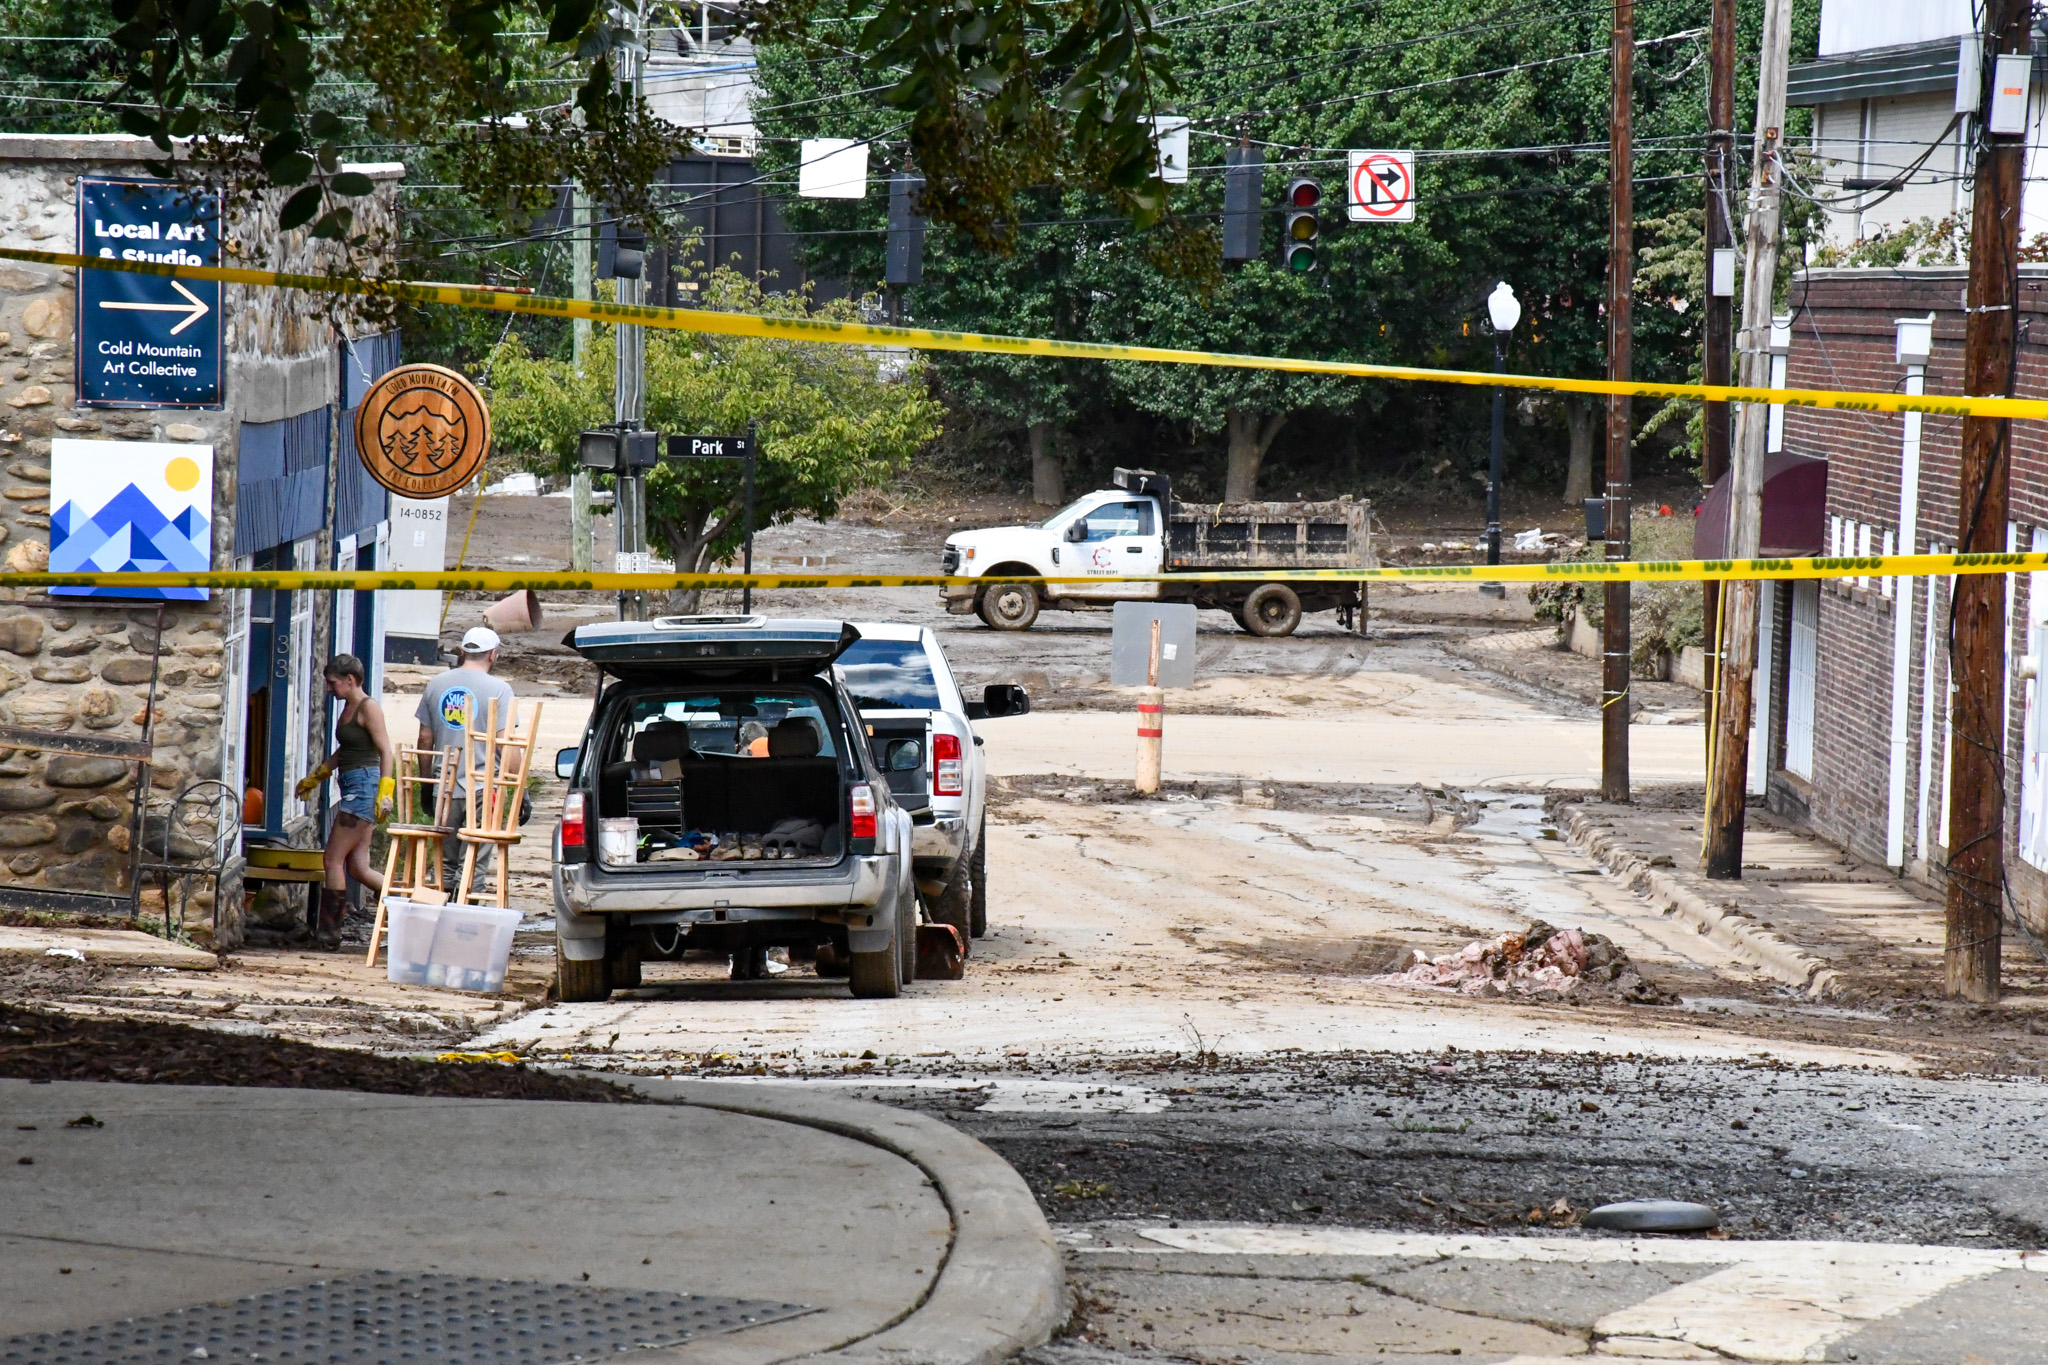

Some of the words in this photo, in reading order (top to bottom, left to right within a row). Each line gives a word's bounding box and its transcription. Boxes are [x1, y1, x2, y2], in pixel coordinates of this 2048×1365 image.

[94, 219, 160, 240] Local
[165, 223, 206, 241] Art
[122, 248, 203, 267] Studio
[98, 340, 133, 355] Cold
[137, 342, 202, 358] Mountain
[102, 360, 125, 374] Art
[128, 361, 198, 377] Collective
[385, 378, 407, 395] COLD
[408, 374, 460, 397] MOUNTAIN
[691, 439, 724, 455] Park
[736, 440, 745, 449] St
[400, 507, 443, 521] 14-0852
